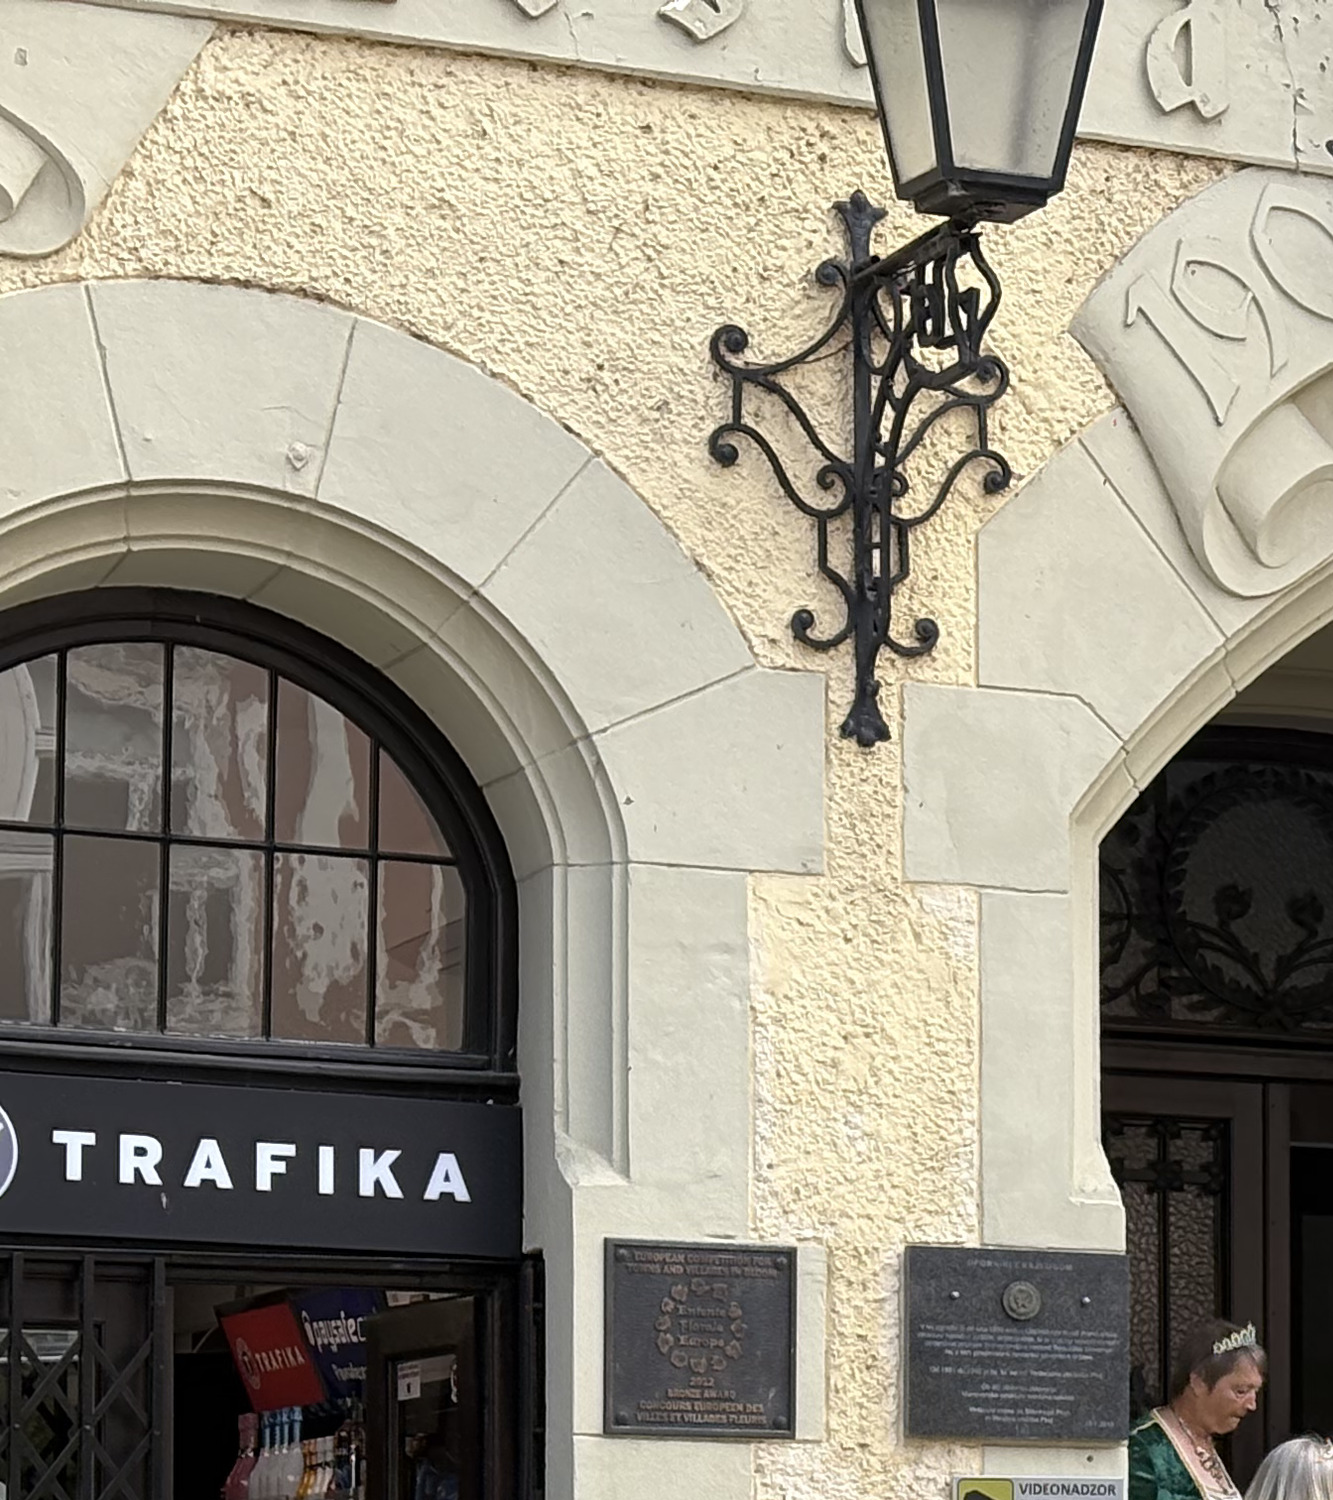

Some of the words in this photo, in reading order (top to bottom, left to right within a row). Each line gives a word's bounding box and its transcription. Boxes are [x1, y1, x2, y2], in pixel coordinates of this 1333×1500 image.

[53, 1130, 471, 1202] TRAFIKA
[662, 1265, 684, 1274] AND
[256, 1346, 305, 1373] TRAFIKA
[1019, 1482, 1116, 1497] VIDEONADZOR
